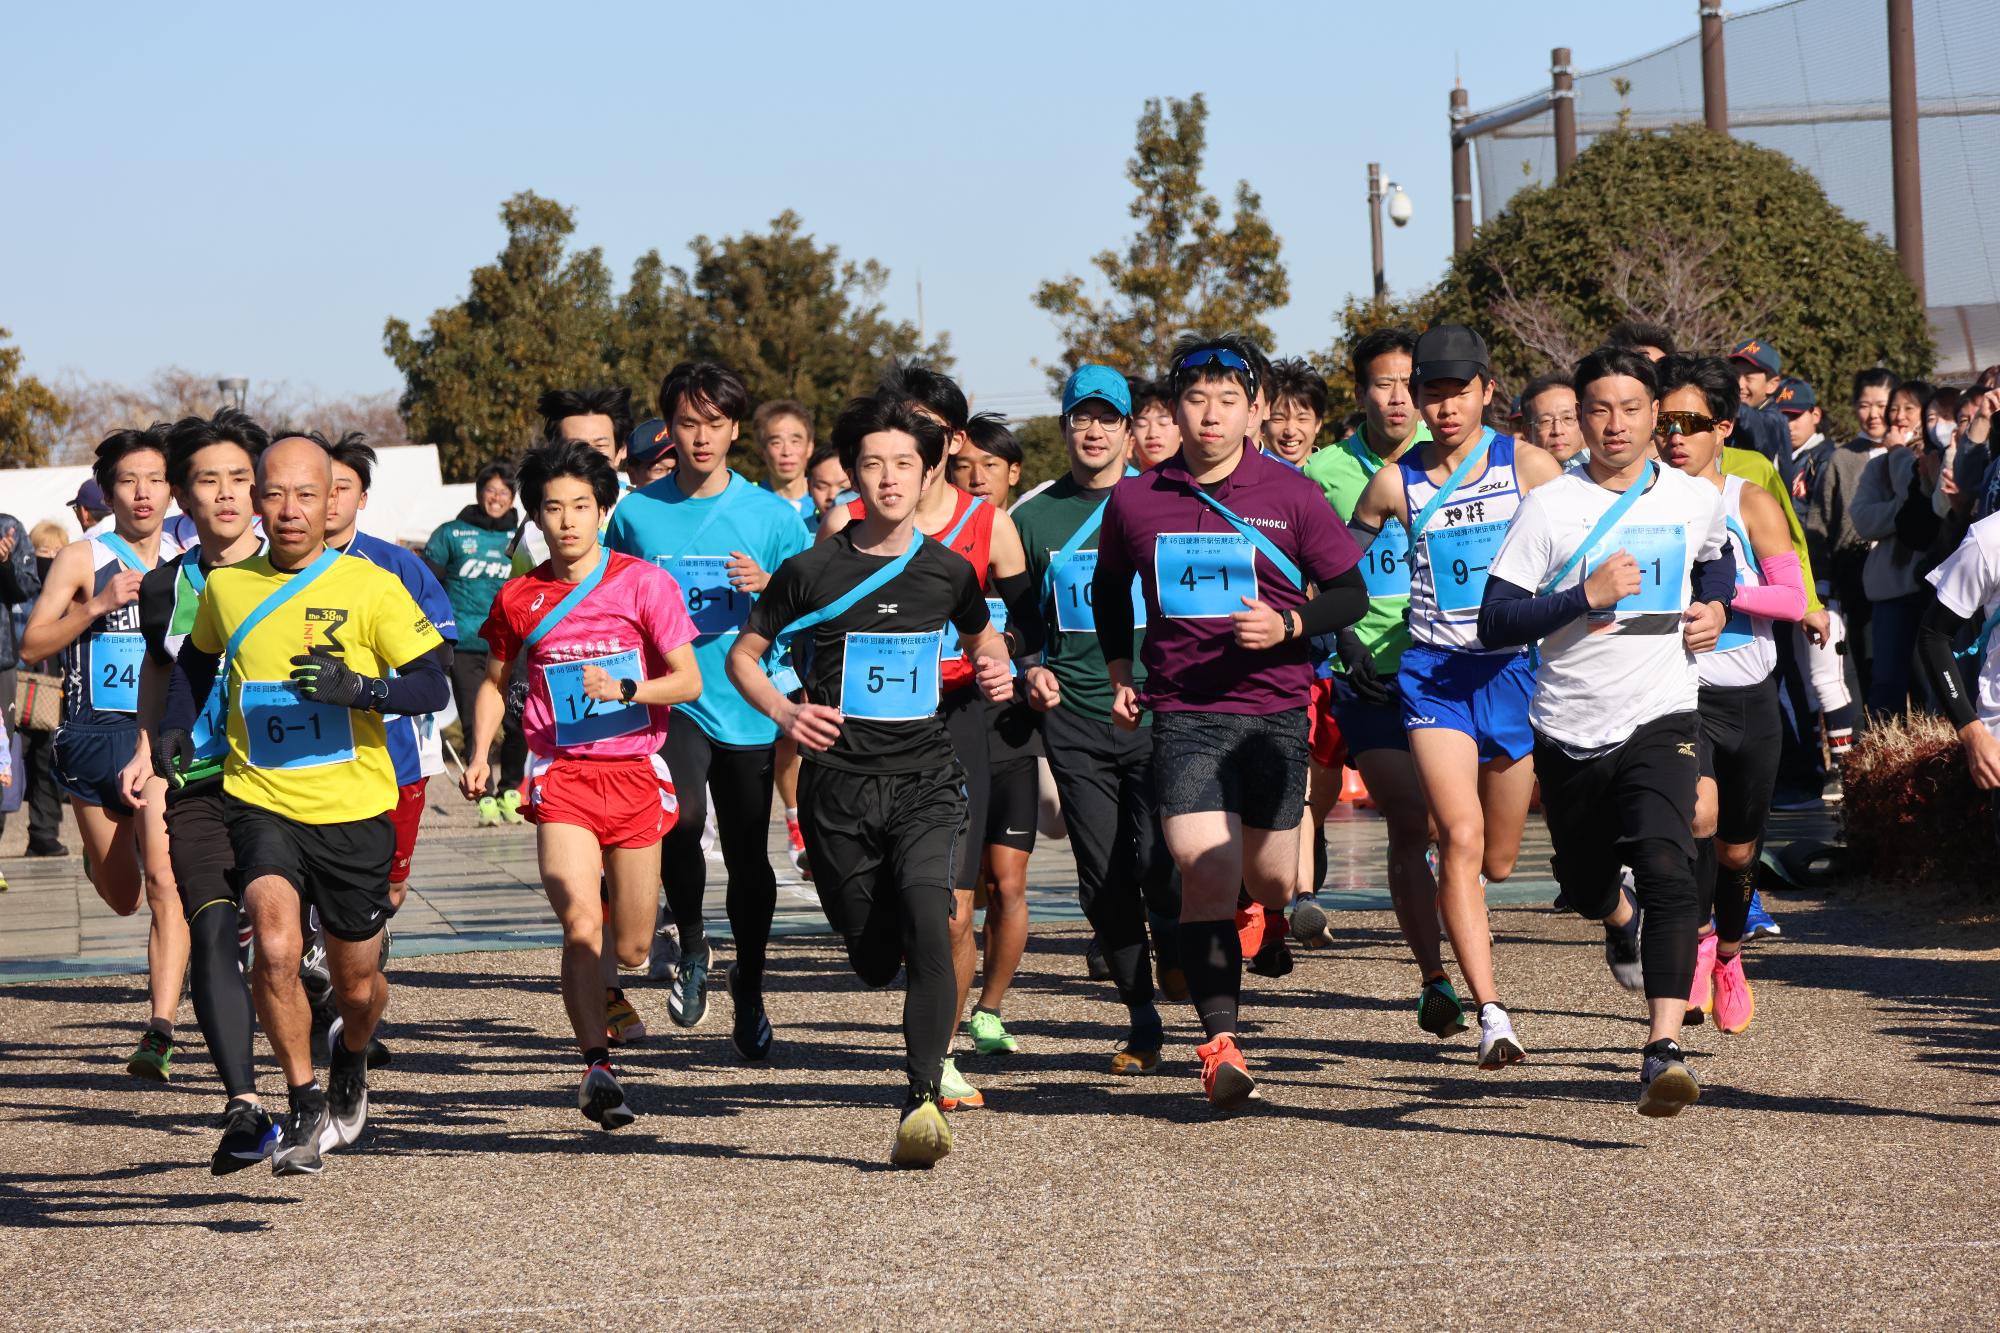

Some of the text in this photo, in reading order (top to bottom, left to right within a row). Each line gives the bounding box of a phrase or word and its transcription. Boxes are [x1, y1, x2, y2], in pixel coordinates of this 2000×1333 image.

[1243, 517, 1287, 530] RYOHOKU
[1180, 566, 1229, 591] 4-1
[1452, 557, 1495, 585] 9-
[688, 586, 734, 611] 8-1
[321, 609, 344, 622] 38th
[103, 664, 140, 689] 24
[867, 666, 918, 693] 5-1
[267, 711, 321, 744] 6-1
